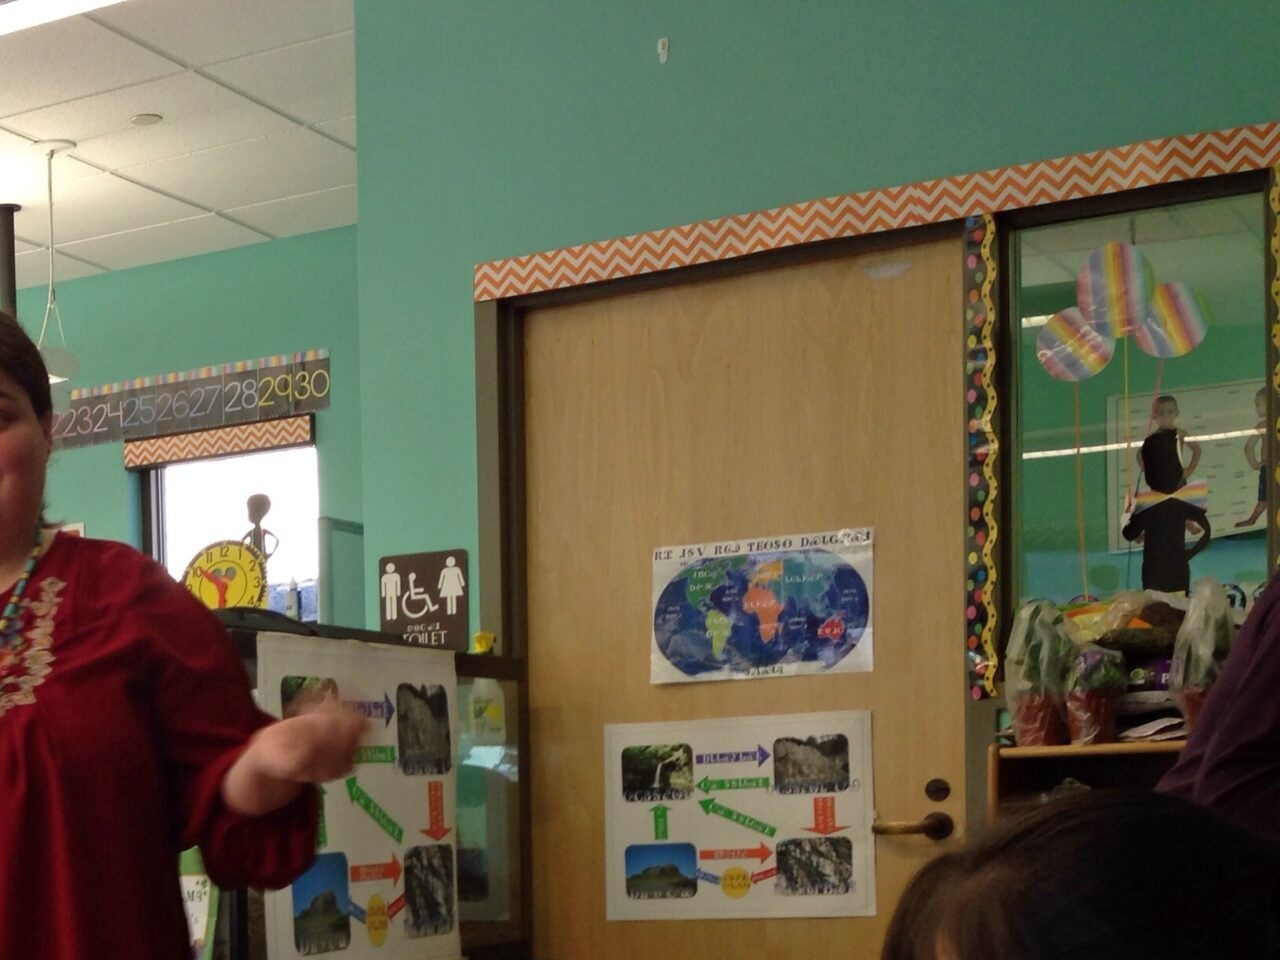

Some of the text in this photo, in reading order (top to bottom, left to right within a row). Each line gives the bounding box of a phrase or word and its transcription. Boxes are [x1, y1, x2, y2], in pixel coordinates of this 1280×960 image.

[62, 406, 93, 436] 23
[93, 401, 123, 433] 24
[123, 394, 155, 428] 25
[157, 389, 190, 421] 26
[189, 384, 221, 417] 27
[224, 379, 259, 412] 28
[257, 374, 292, 407] 29
[294, 369, 330, 399] 30
[206, 551, 213, 564] 11
[220, 545, 230, 558] 12
[191, 566, 203, 578] 10
[248, 559, 257, 572] 2
[252, 575, 261, 589] 3
[246, 595, 255, 605] 4
